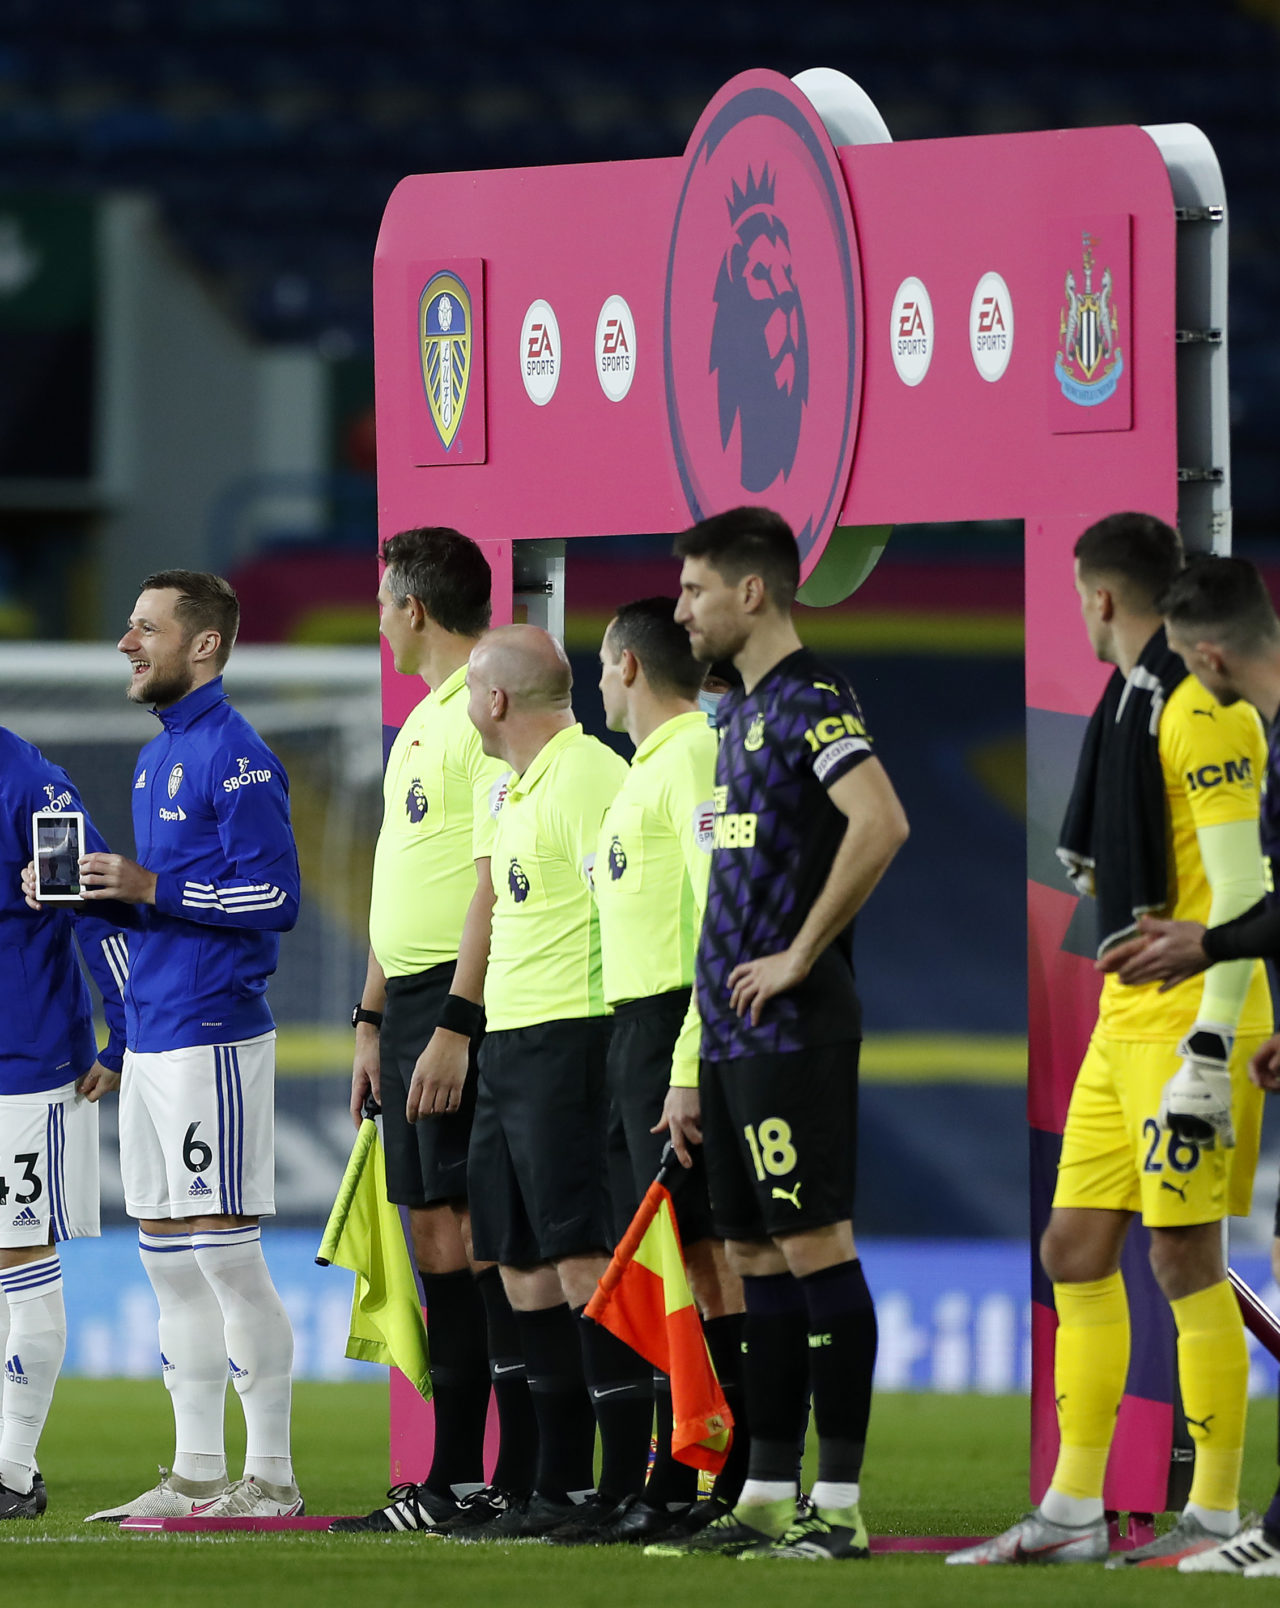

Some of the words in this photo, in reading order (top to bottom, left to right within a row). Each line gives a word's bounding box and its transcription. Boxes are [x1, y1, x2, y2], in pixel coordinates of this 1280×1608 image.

[898, 302, 926, 337] EA
[978, 297, 1005, 333] EA
[527, 324, 554, 358] EA
[602, 319, 629, 354] EA
[897, 338, 927, 355] SPORTS
[976, 334, 1007, 352] SPORTS
[526, 359, 556, 376] SPORTS
[601, 355, 631, 372] SPORTS
[804, 713, 867, 753] ICM
[223, 769, 272, 793] SBOTOP
[1187, 757, 1250, 791] ICM
[182, 1120, 213, 1173] 6
[743, 1116, 798, 1182] 18
[1143, 1117, 1200, 1174] 26
[187, 1187, 213, 1197] adidas
[12, 1218, 41, 1228] adidas
